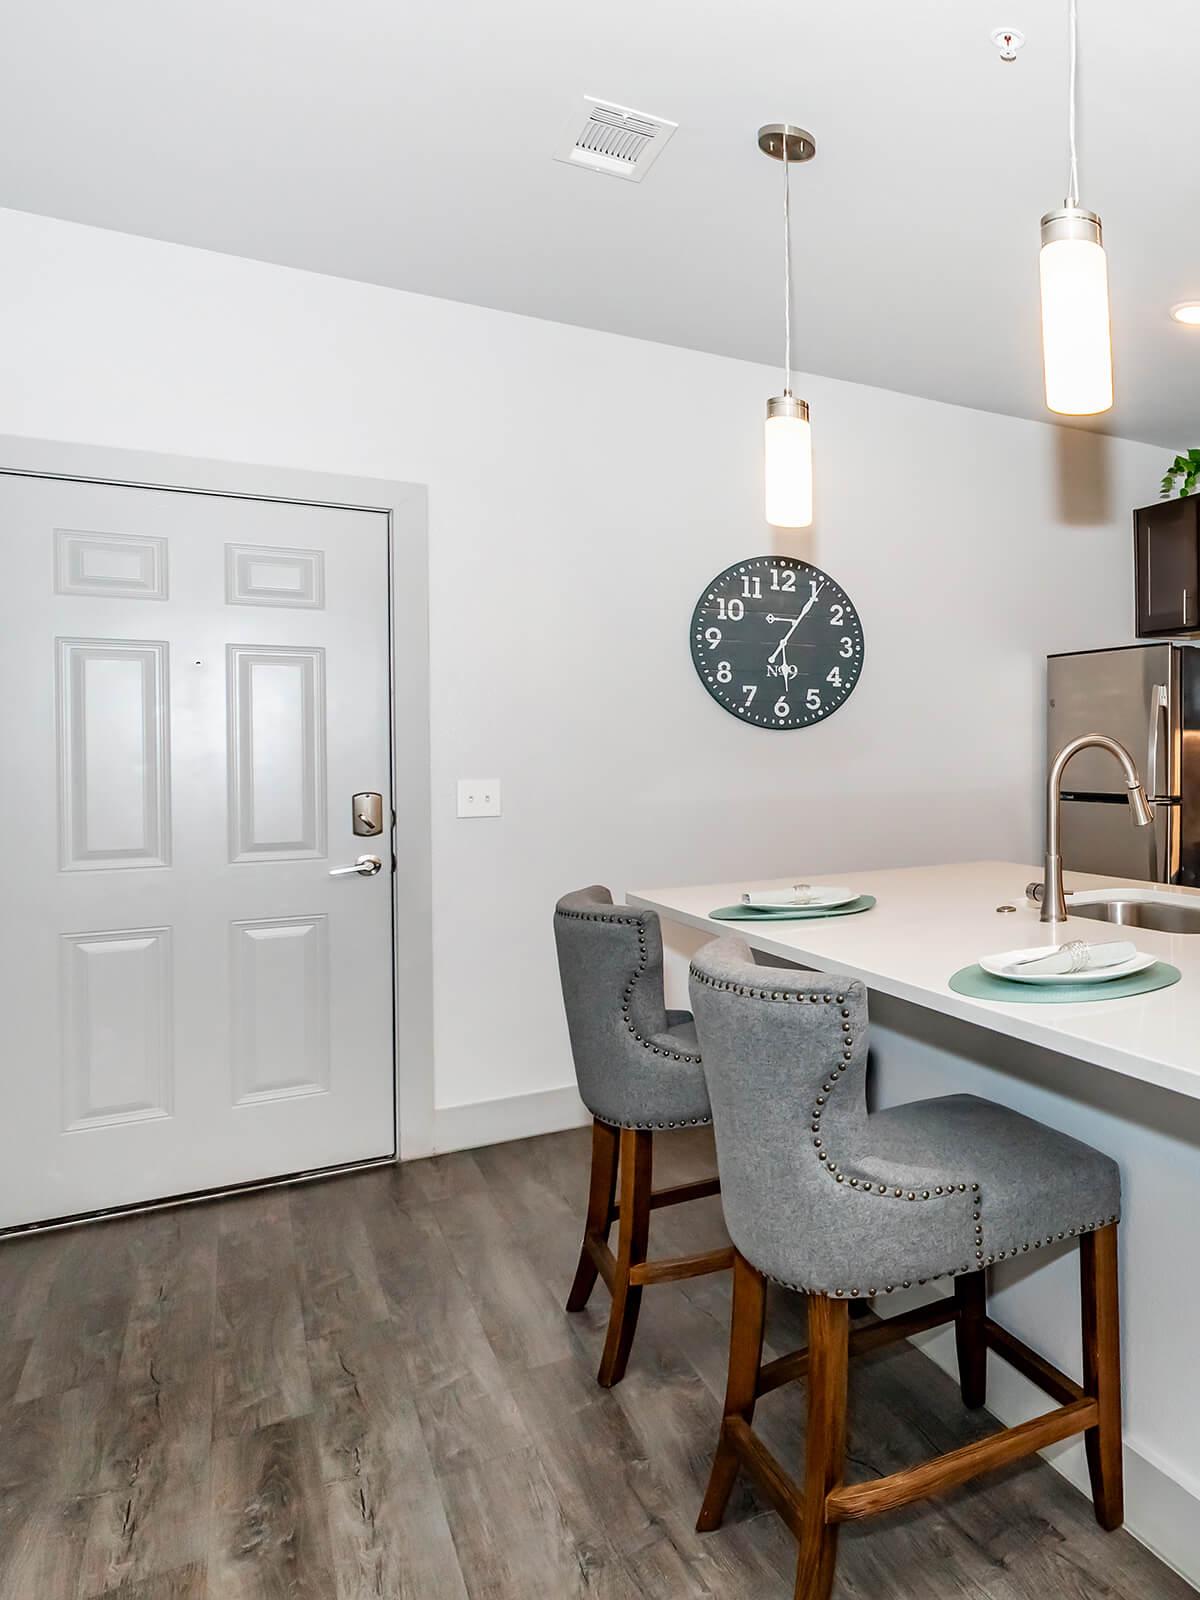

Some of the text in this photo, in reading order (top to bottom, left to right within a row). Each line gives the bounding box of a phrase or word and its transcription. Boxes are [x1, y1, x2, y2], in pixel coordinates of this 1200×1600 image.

[741, 575, 763, 599] 11
[769, 569, 796, 592] 12
[808, 580, 819, 602] 1
[716, 597, 745, 621] 10
[829, 604, 844, 626] 2
[704, 627, 722, 649] 9
[839, 636, 853, 658] 3
[716, 661, 732, 683] 8
[825, 666, 843, 687] 4
[742, 685, 757, 706] 7
[774, 695, 790, 717] 6
[805, 688, 821, 710] 5
